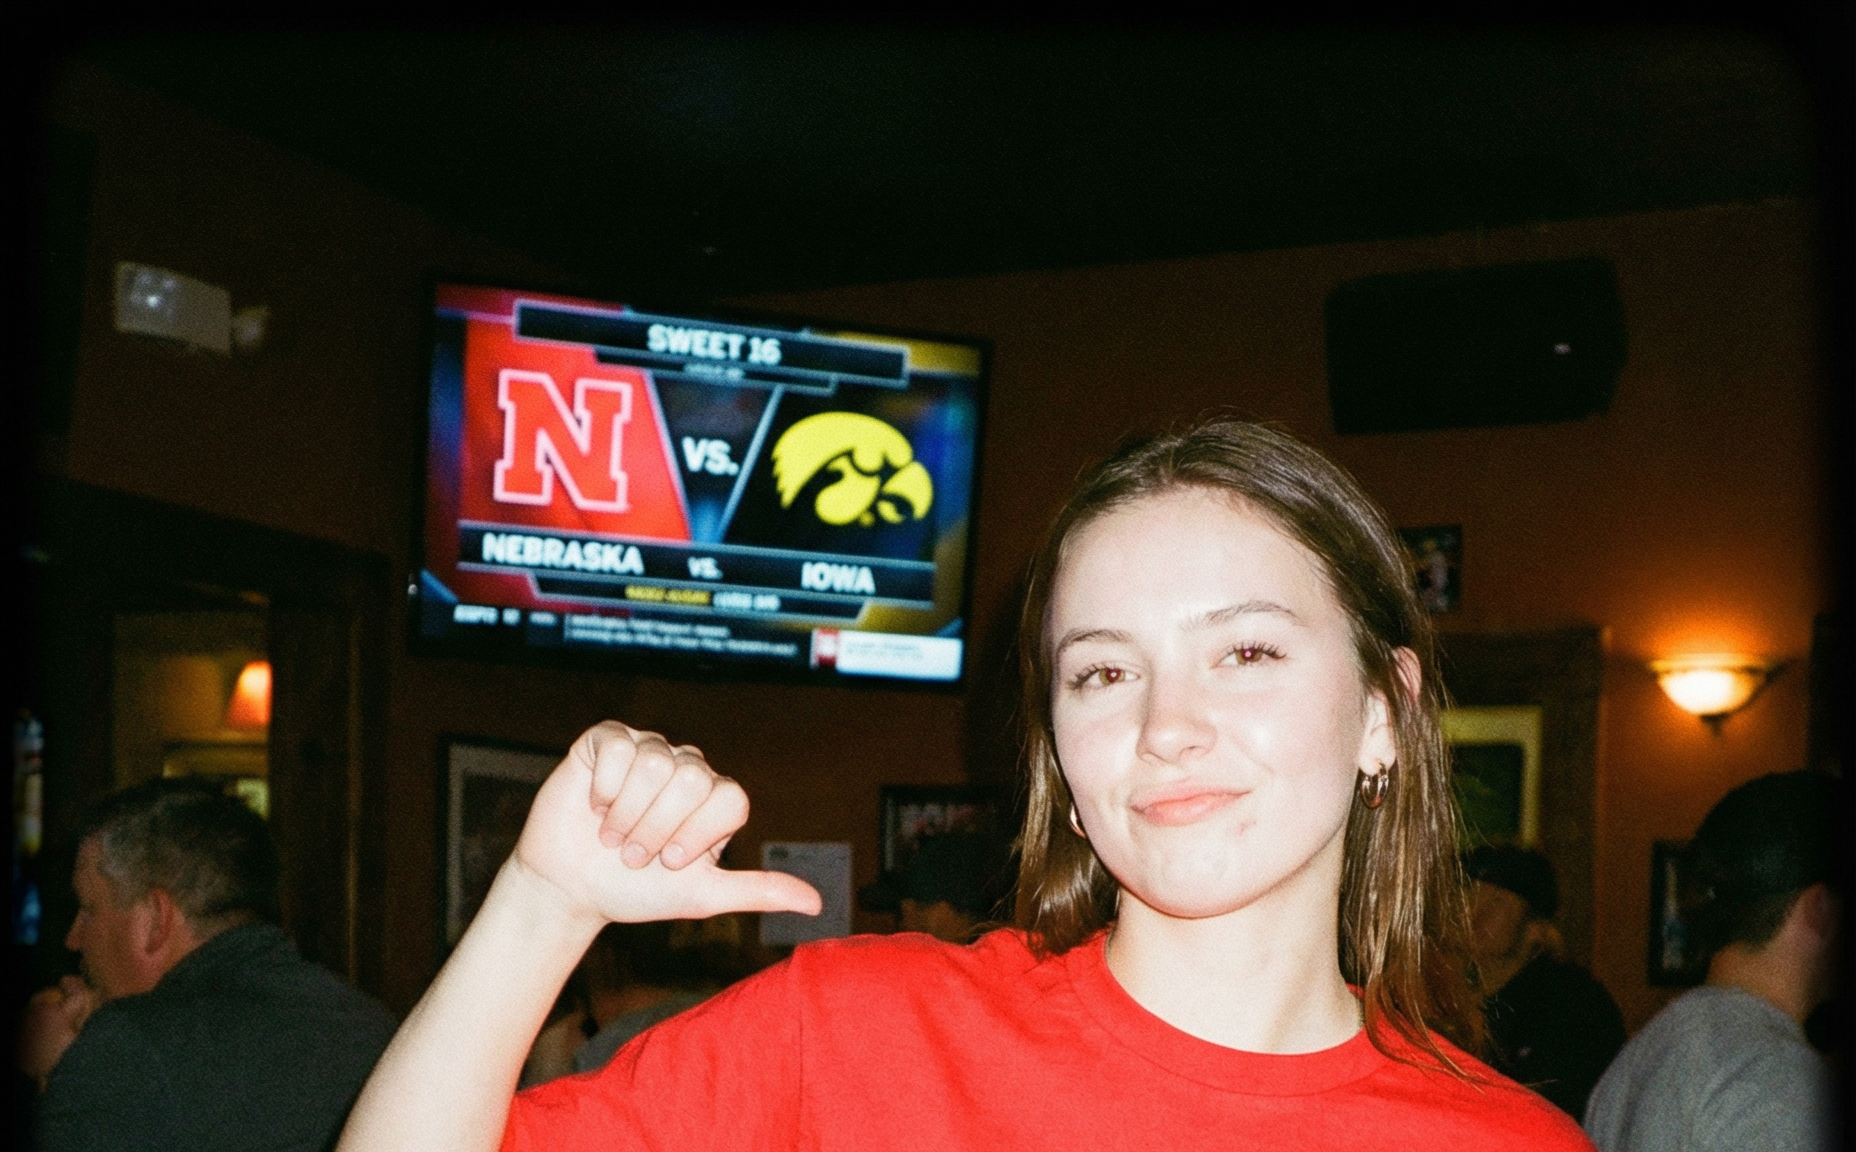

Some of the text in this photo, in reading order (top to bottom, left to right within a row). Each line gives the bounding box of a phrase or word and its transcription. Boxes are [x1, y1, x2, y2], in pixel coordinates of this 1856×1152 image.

[647, 323, 782, 366] SWEET 16
[494, 368, 632, 513] N
[682, 436, 740, 476] VS.
[482, 532, 646, 575] NEBRASKA
[801, 561, 876, 594] IOWA
